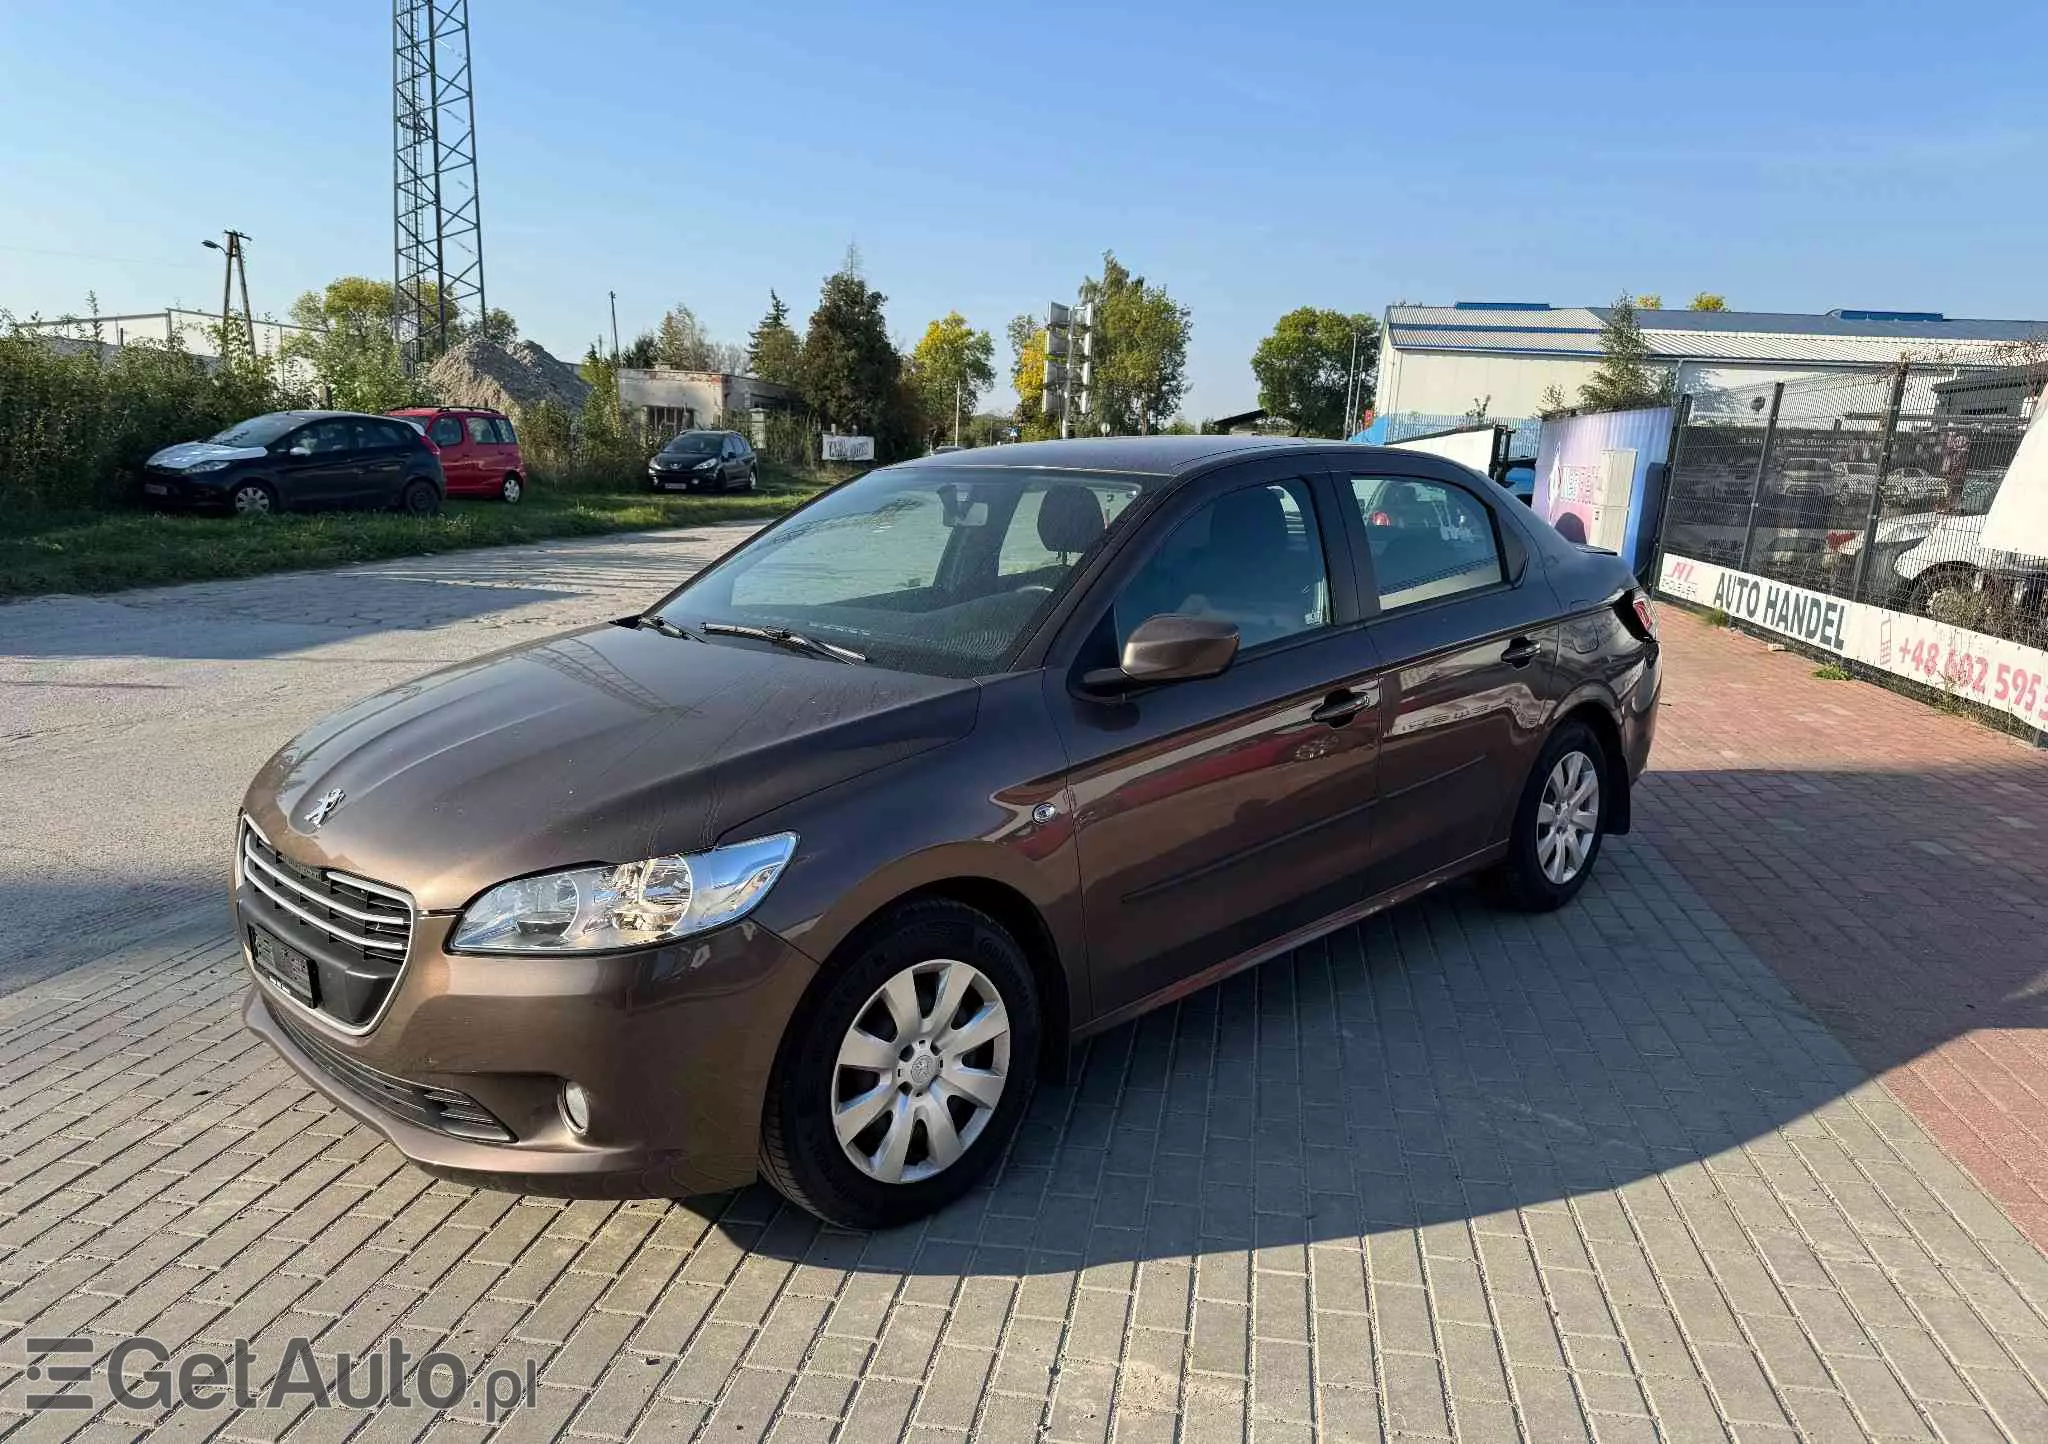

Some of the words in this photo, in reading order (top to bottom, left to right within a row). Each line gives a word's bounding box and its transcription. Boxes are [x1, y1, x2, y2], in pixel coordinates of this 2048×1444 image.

[1713, 572, 1761, 618] AUTO
[1763, 586, 1845, 650] HANDEL
[1899, 637, 1939, 676] +48
